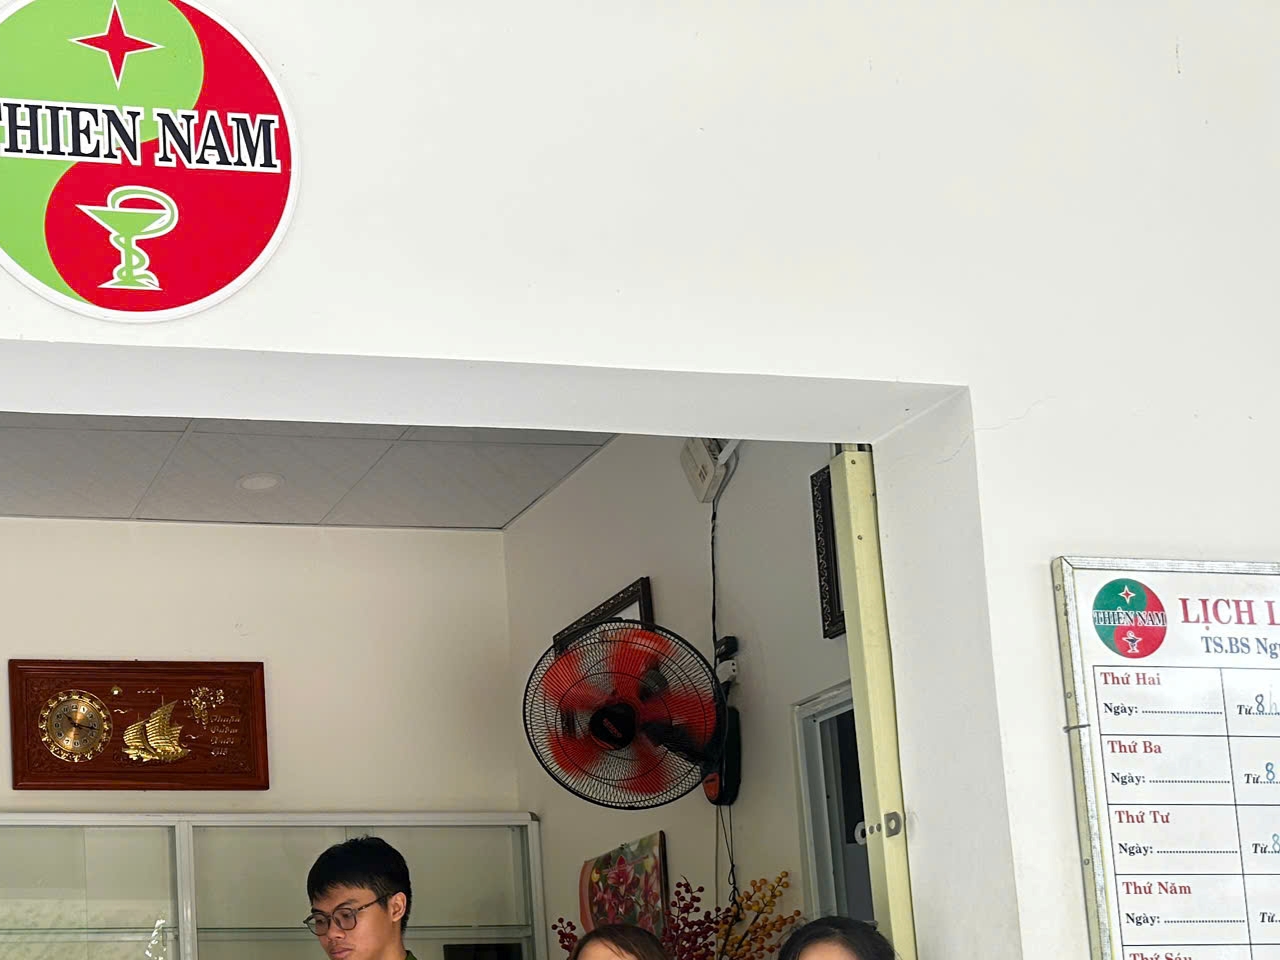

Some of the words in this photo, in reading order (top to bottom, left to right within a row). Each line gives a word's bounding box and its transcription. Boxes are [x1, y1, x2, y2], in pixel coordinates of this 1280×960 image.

[157, 111, 278, 168] NAM
[1136, 611, 1166, 626] NAM
[1178, 598, 1257, 631] LỊCH
[1201, 636, 1251, 654] TS.BS
[1255, 637, 1280, 659] Ng
[1101, 671, 1130, 686] Thứ
[1136, 672, 1161, 686] Hai
[1103, 703, 1138, 715] Ngày:
[1237, 703, 1253, 715] Từ
[1108, 740, 1138, 754] Thứ
[1143, 741, 1162, 754] Ba
[1266, 761, 1275, 782] 8
[1111, 773, 1146, 785] Ngày:
[1245, 773, 1260, 785] Từ
[1116, 811, 1145, 824] Thứ
[1150, 810, 1170, 824] Tư
[1119, 843, 1153, 855] Ngày:
[1252, 842, 1268, 854] Từ
[1122, 881, 1152, 895] Thứ
[1158, 881, 1192, 895] Năm
[1126, 913, 1160, 926] Ngày:
[1260, 911, 1275, 923] Từ
